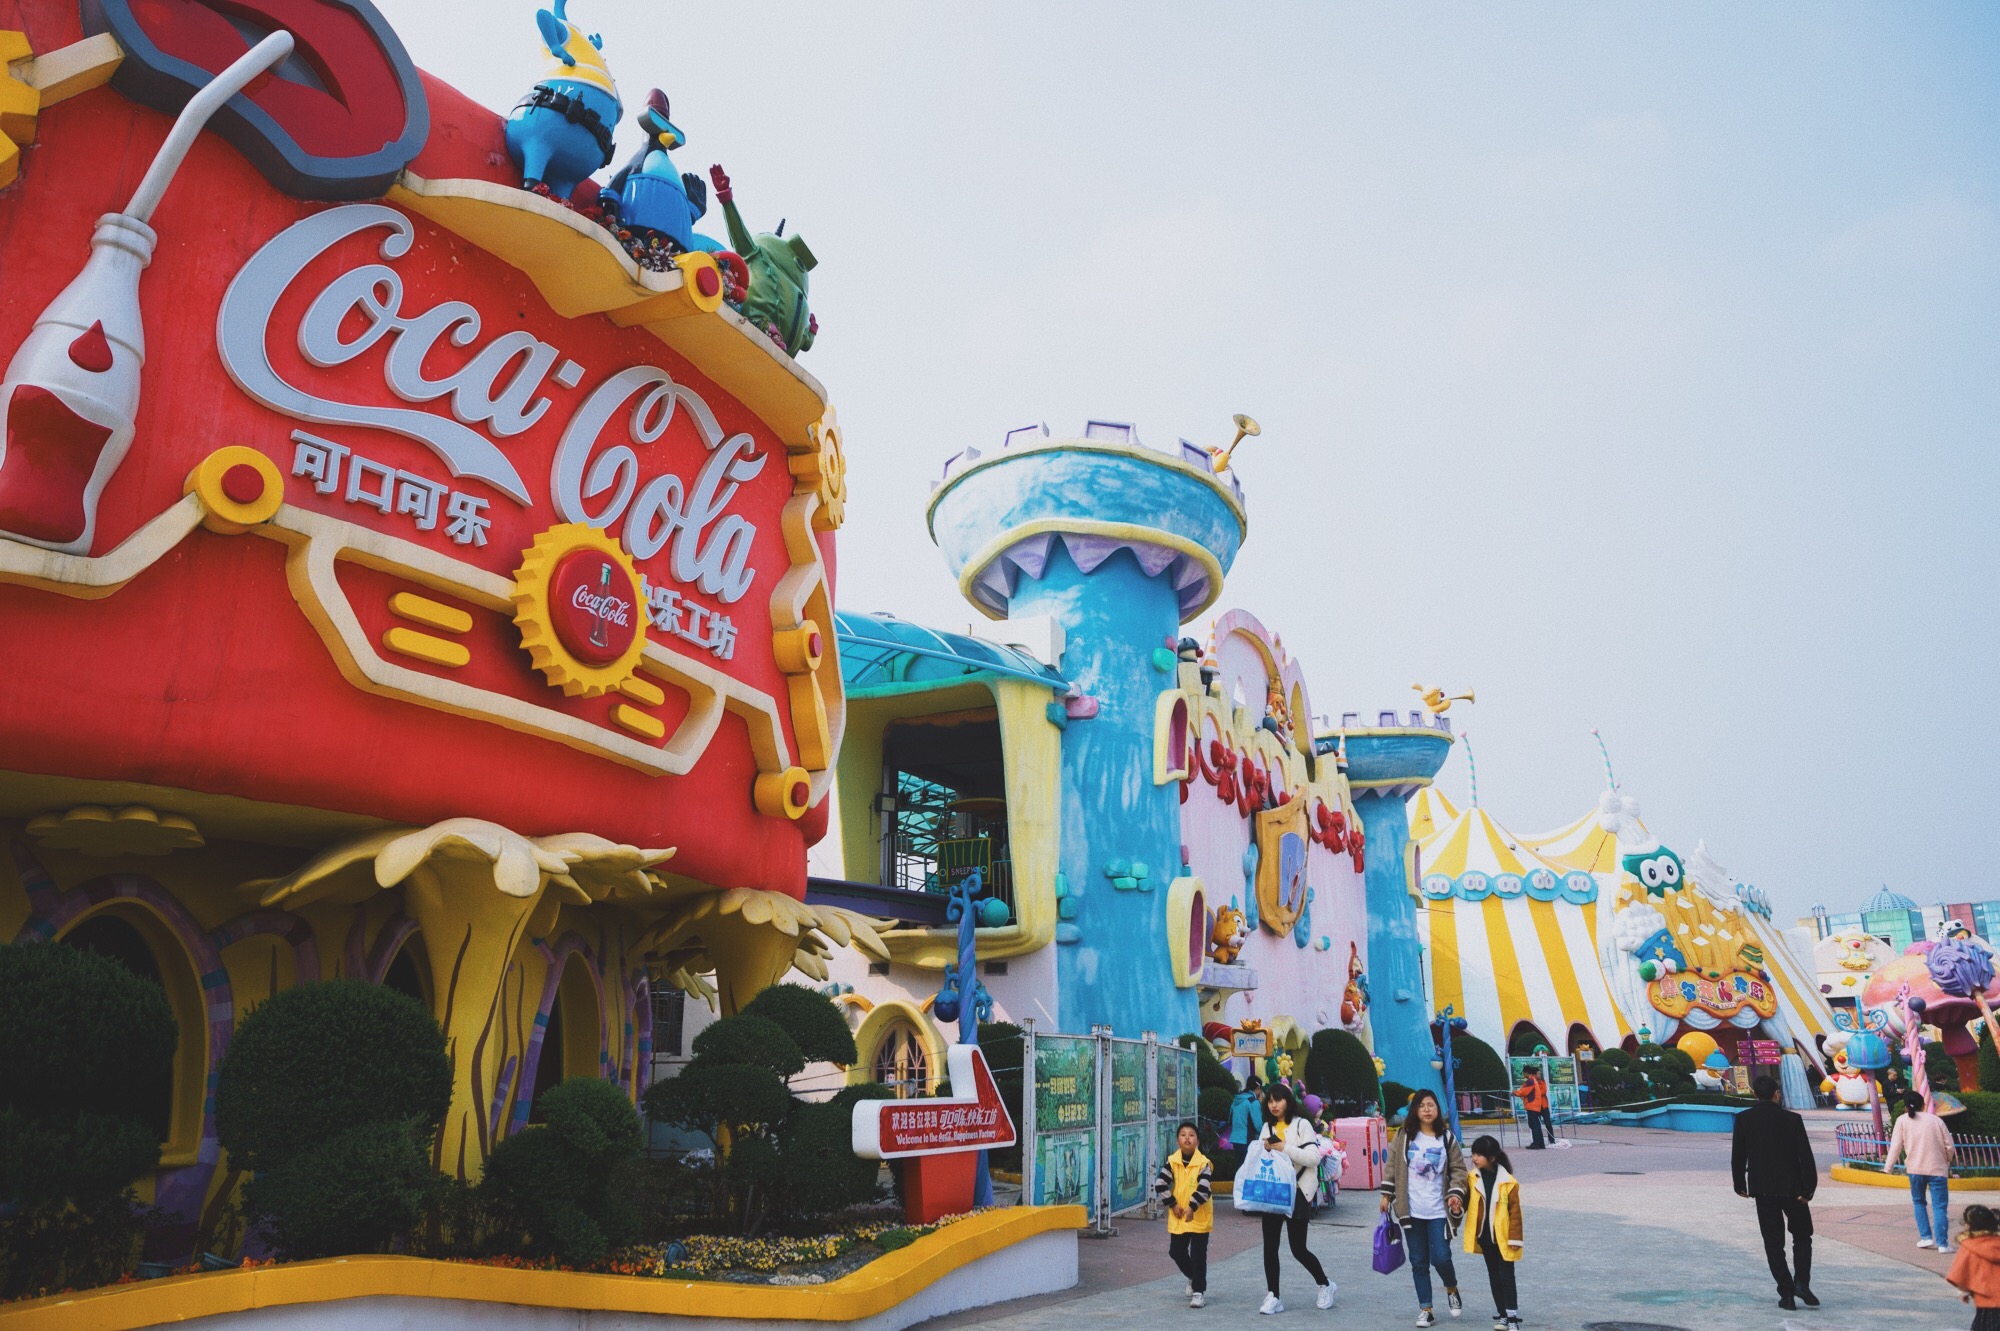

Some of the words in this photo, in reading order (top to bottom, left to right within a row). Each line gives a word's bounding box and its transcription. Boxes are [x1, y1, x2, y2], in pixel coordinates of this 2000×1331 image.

[216, 204, 769, 604] Coca-Cola
[290, 429, 492, 547] 可口可乐
[896, 1133, 922, 1145] Welcome
[923, 1133, 928, 1143] to
[929, 1131, 938, 1142] the
[953, 1129, 978, 1142] Happiness
[978, 1129, 996, 1140] Factory
